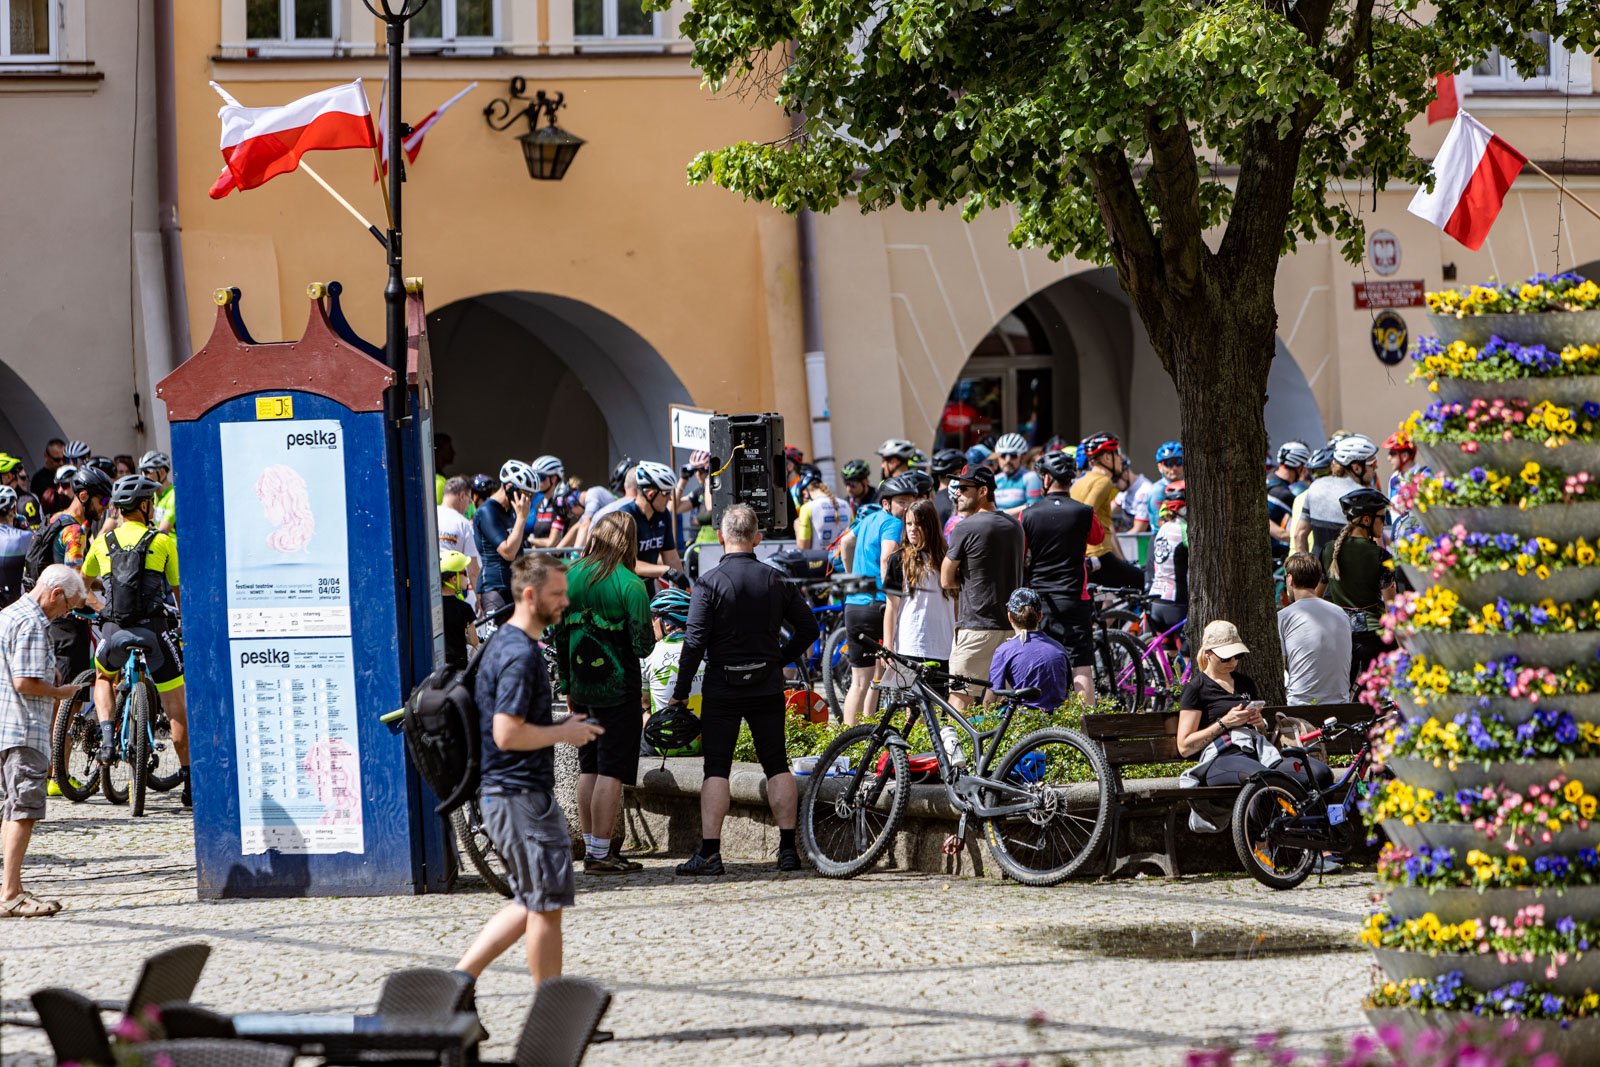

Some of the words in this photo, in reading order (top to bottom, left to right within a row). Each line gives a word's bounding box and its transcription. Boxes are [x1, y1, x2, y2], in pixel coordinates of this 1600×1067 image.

[674, 412, 680, 444] 1
[684, 425, 707, 440] SEKTOR
[287, 429, 337, 450] pestka
[318, 578, 340, 586] 30/04
[318, 586, 340, 595] 04/05
[241, 648, 290, 668] pestka
